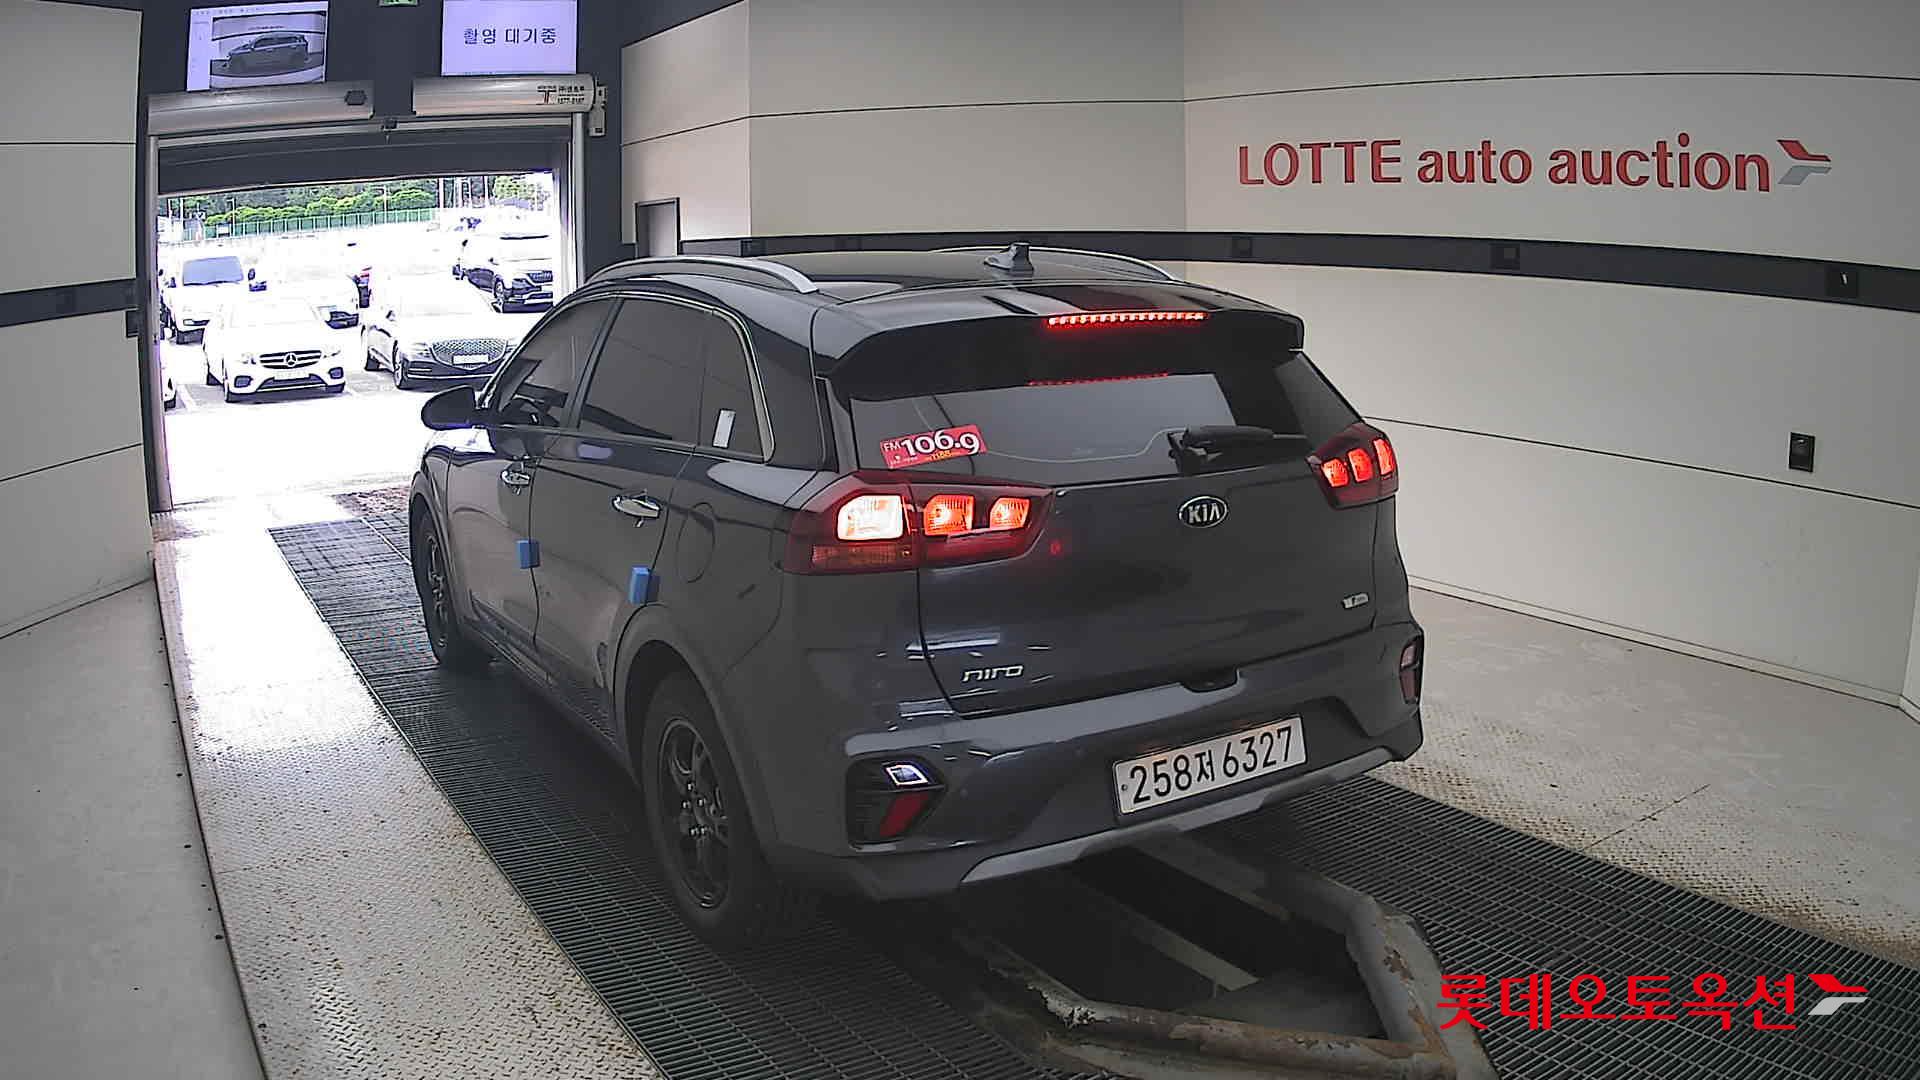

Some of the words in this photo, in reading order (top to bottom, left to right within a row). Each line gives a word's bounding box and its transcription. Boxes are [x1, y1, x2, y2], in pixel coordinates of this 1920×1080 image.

[504, 28, 557, 45] 대기중
[1239, 139, 1401, 186] LOTTE
[1417, 139, 1532, 184] auto
[1549, 132, 1770, 192] auction
[883, 441, 901, 452] FM
[901, 429, 980, 456] 106.9
[1188, 502, 1221, 524] KIA
